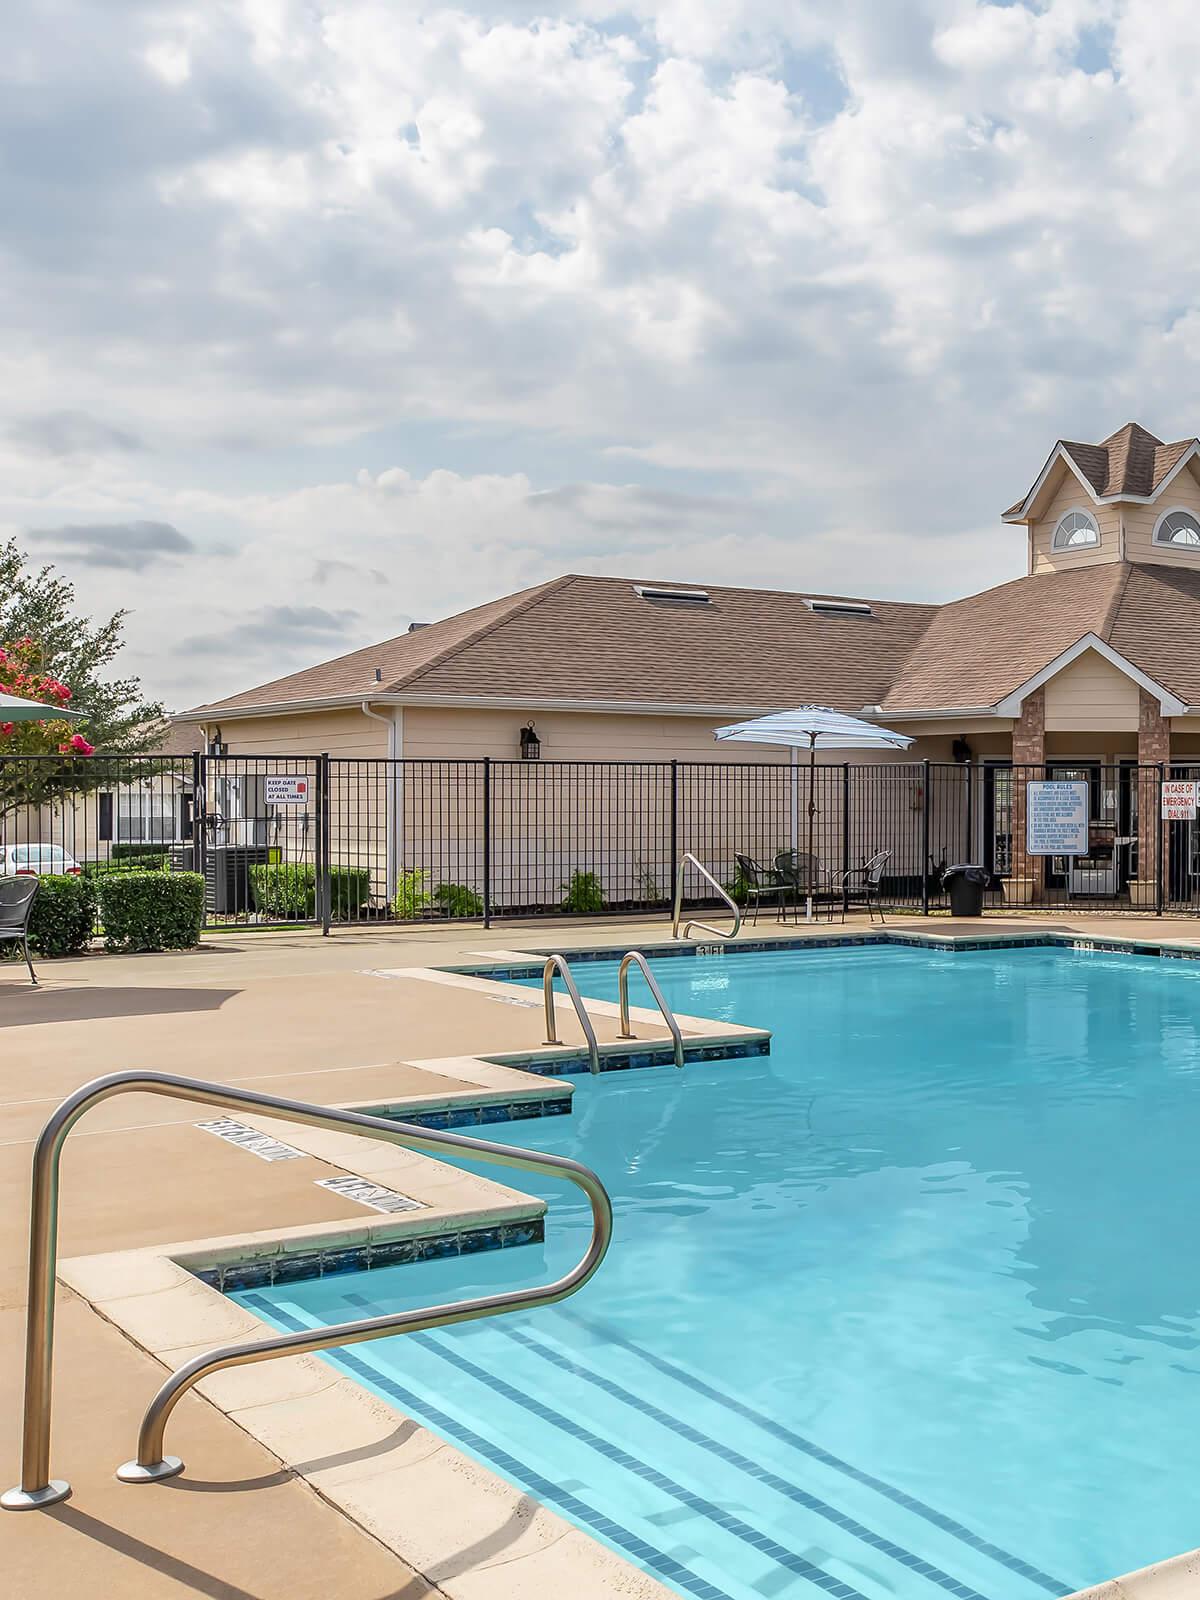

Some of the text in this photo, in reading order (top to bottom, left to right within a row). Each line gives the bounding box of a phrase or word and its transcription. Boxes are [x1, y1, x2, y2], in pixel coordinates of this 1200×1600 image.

[1170, 784, 1185, 794] CASE
[1186, 784, 1193, 794] OF
[1163, 797, 1194, 806] EMERGENCY
[1168, 810, 1180, 818] DIAL
[323, 1177, 378, 1193] 4 FT
